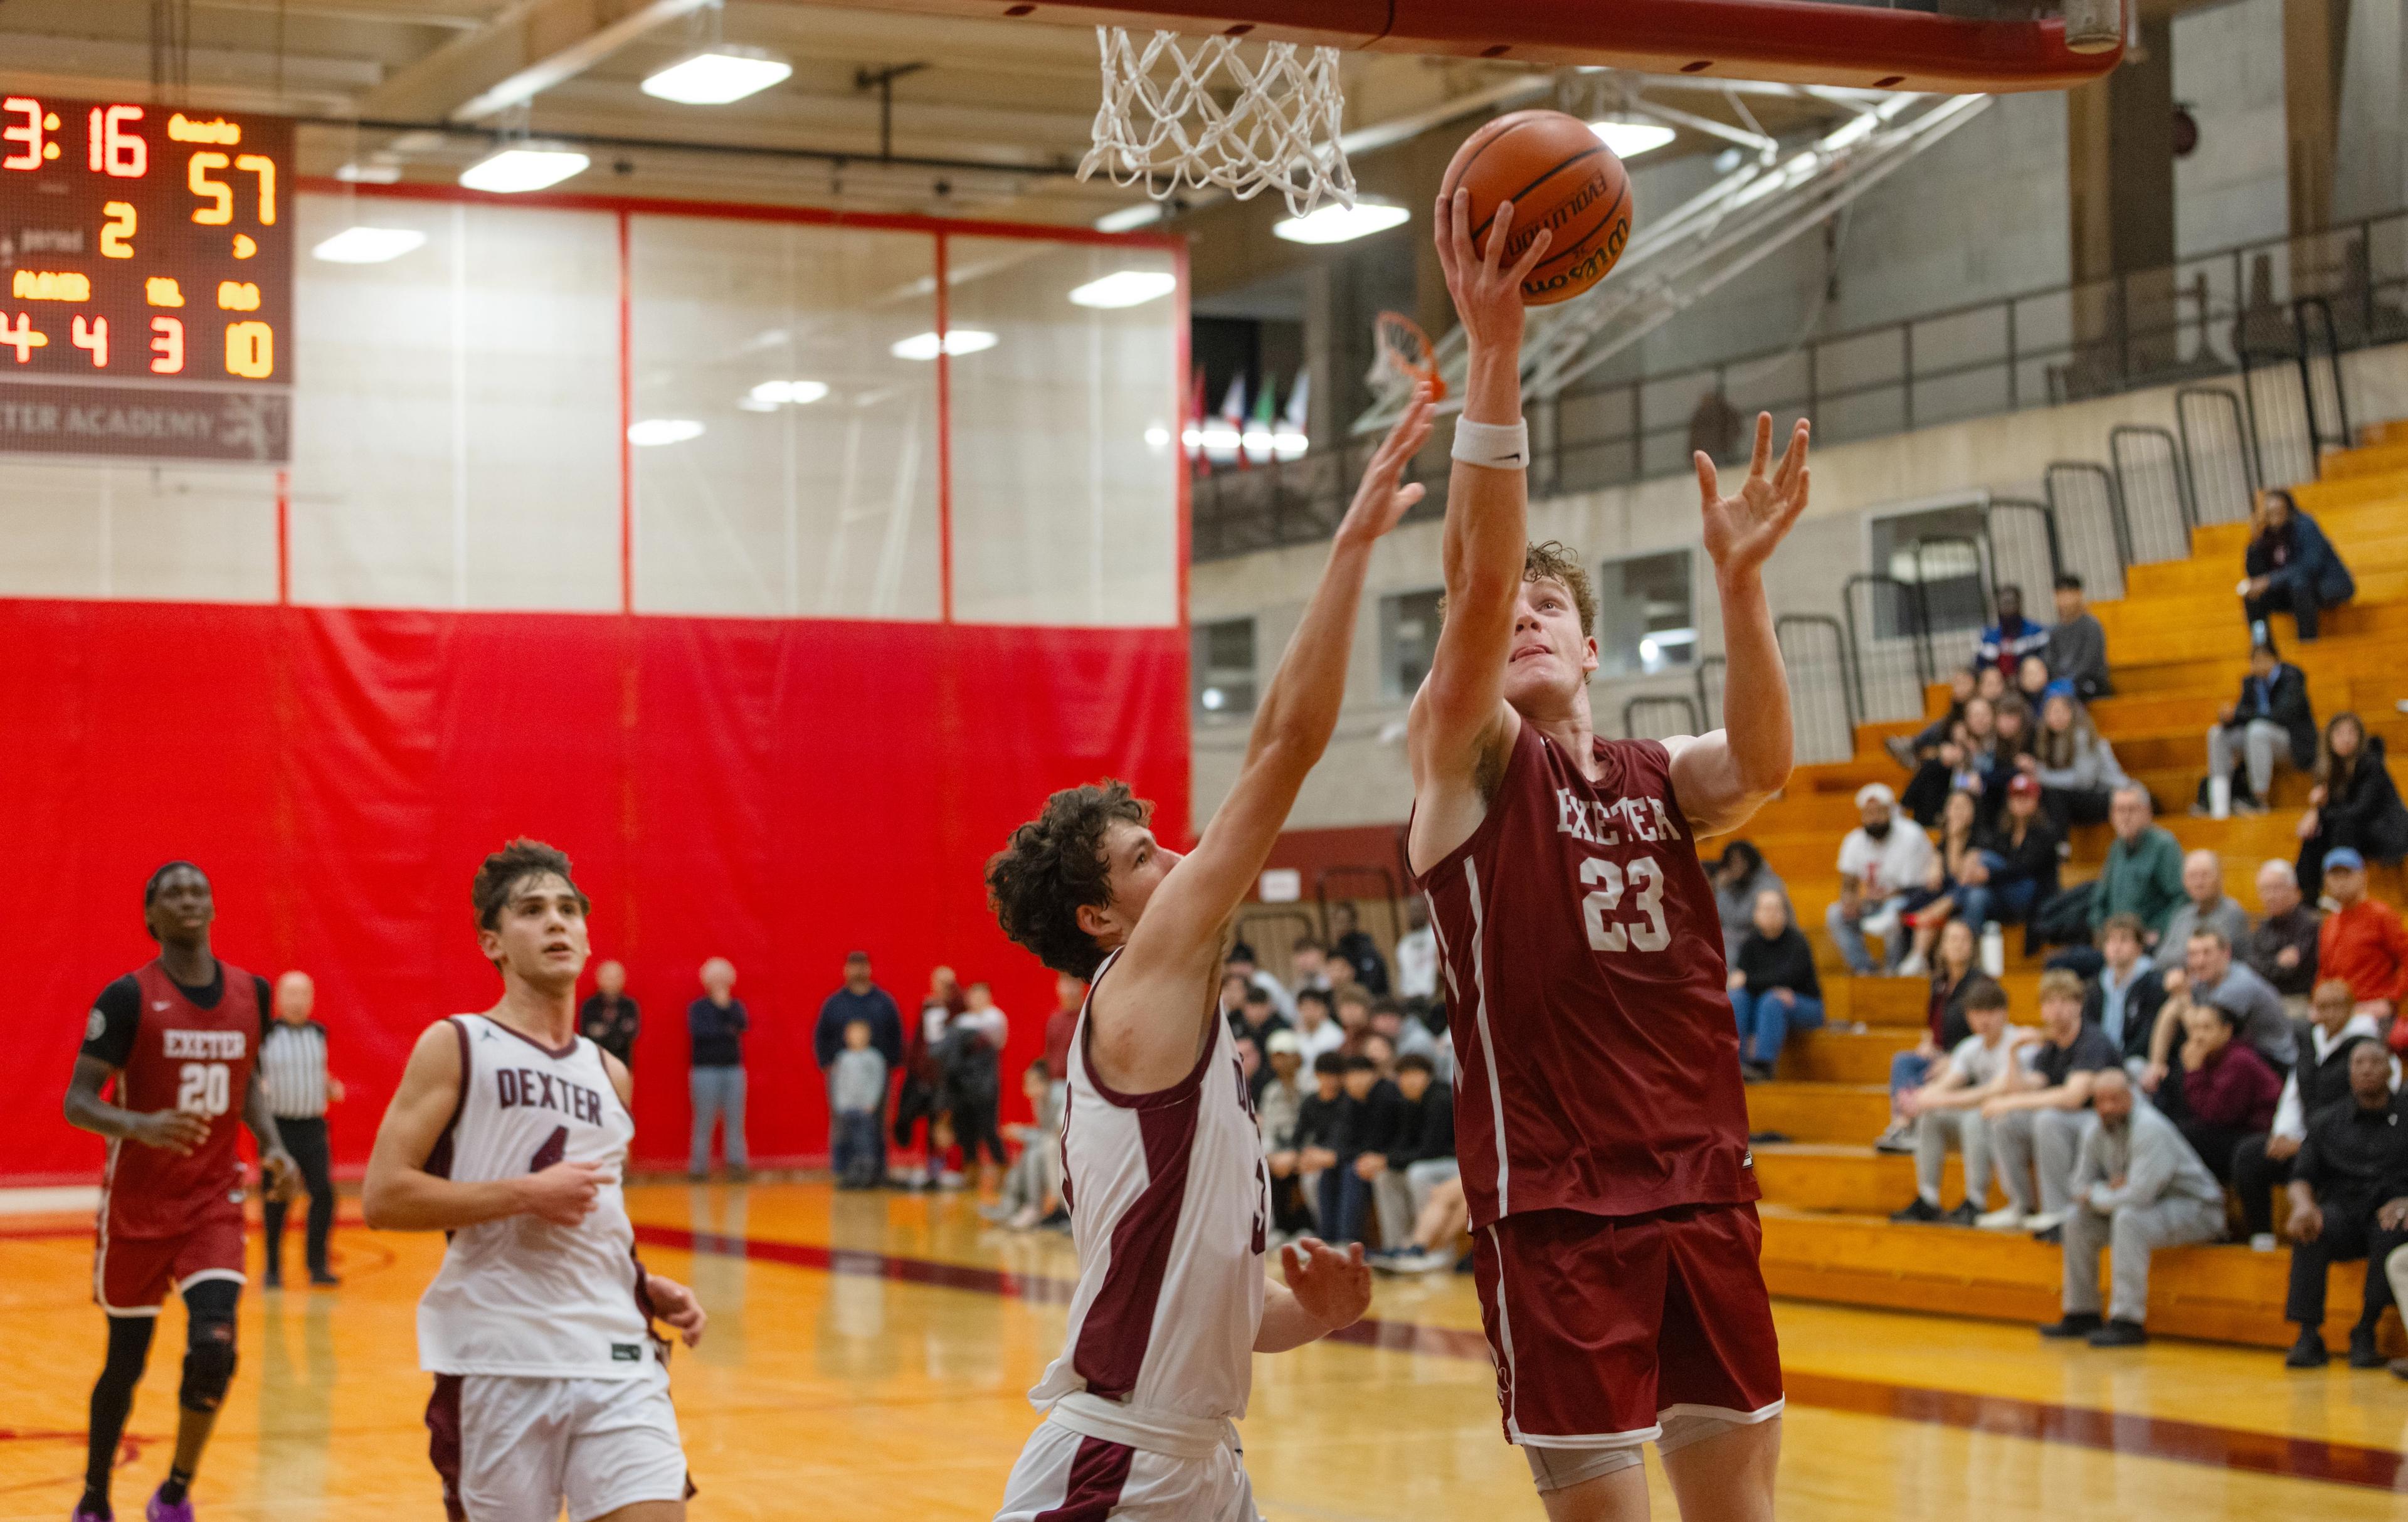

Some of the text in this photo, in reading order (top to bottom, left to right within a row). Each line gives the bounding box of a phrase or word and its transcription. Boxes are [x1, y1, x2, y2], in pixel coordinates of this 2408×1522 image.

[188, 151, 276, 225] 57
[100, 200, 137, 258] 2
[1524, 218, 1629, 295] Wilson
[71, 314, 109, 367] 4
[149, 315, 184, 374] 3
[68, 406, 214, 439] ACADEMY
[1556, 788, 1681, 845] EXETER
[1579, 855, 1672, 952] 23
[178, 1062, 230, 1117] 20
[497, 1067, 604, 1128] DEXTER
